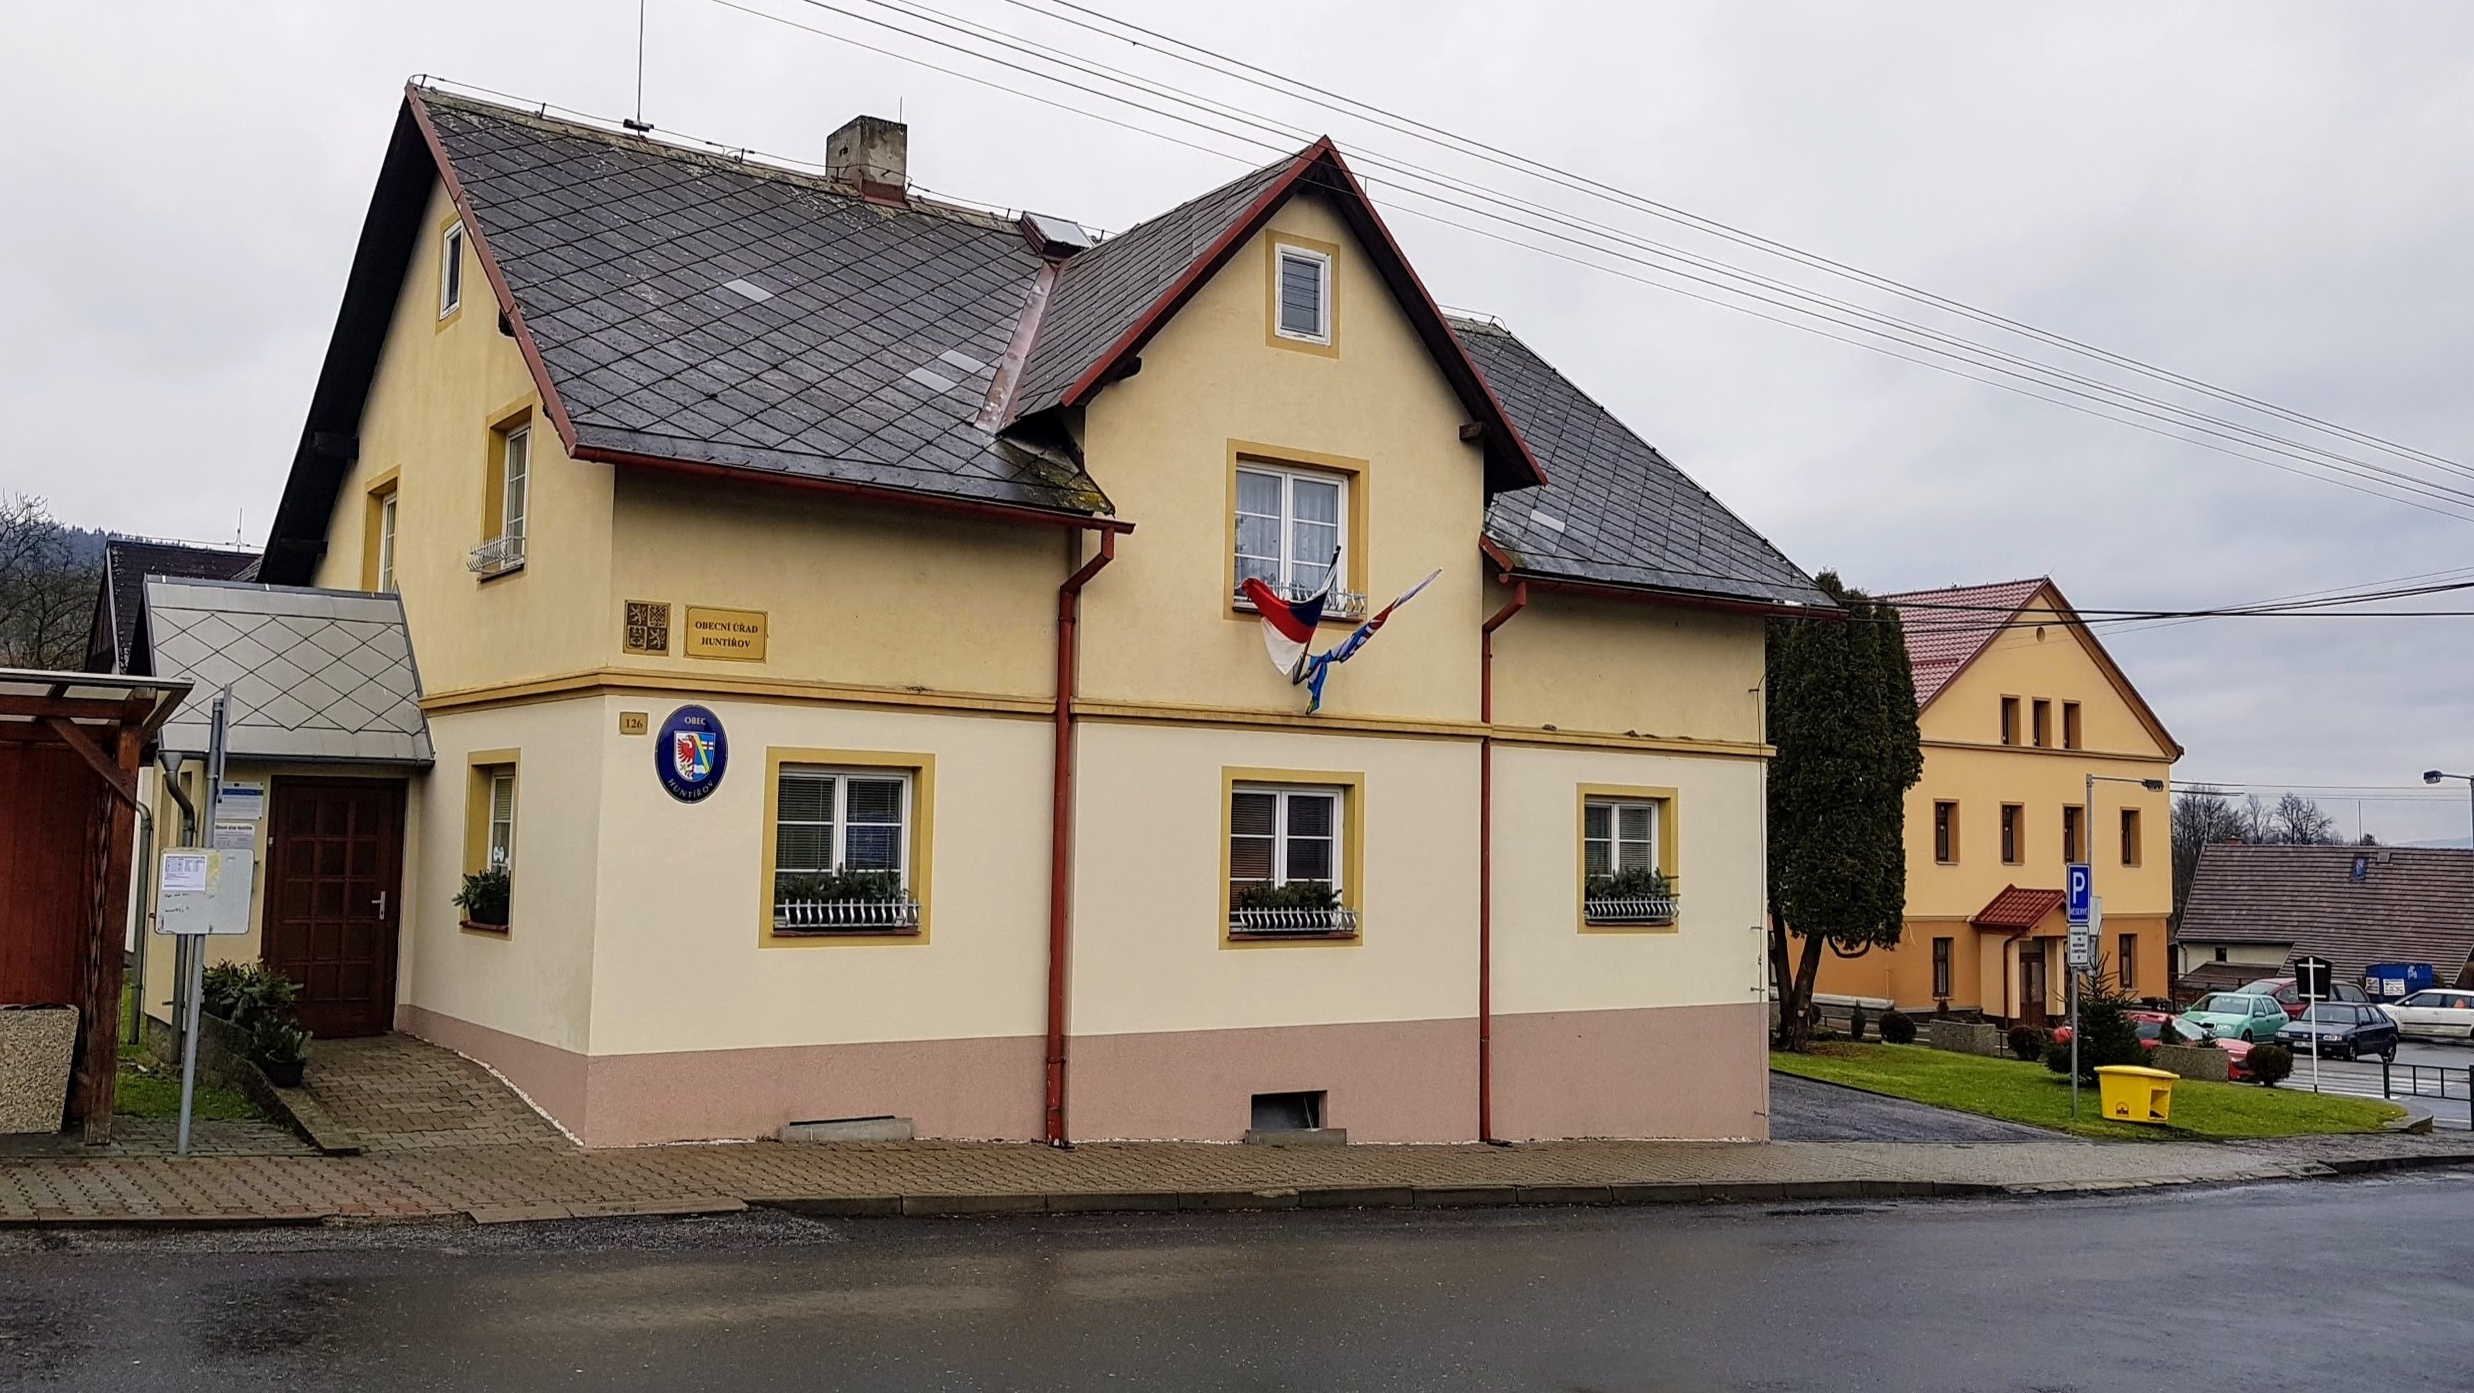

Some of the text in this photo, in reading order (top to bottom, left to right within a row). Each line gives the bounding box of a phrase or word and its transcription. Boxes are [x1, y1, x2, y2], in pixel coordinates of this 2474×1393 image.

[695, 621, 758, 634] OBECNÍ ÚŘAD
[701, 636, 751, 648] HUNTÍŘOV
[625, 718, 643, 728] 126
[684, 716, 706, 725] OBEC
[2072, 871, 2085, 904] P
